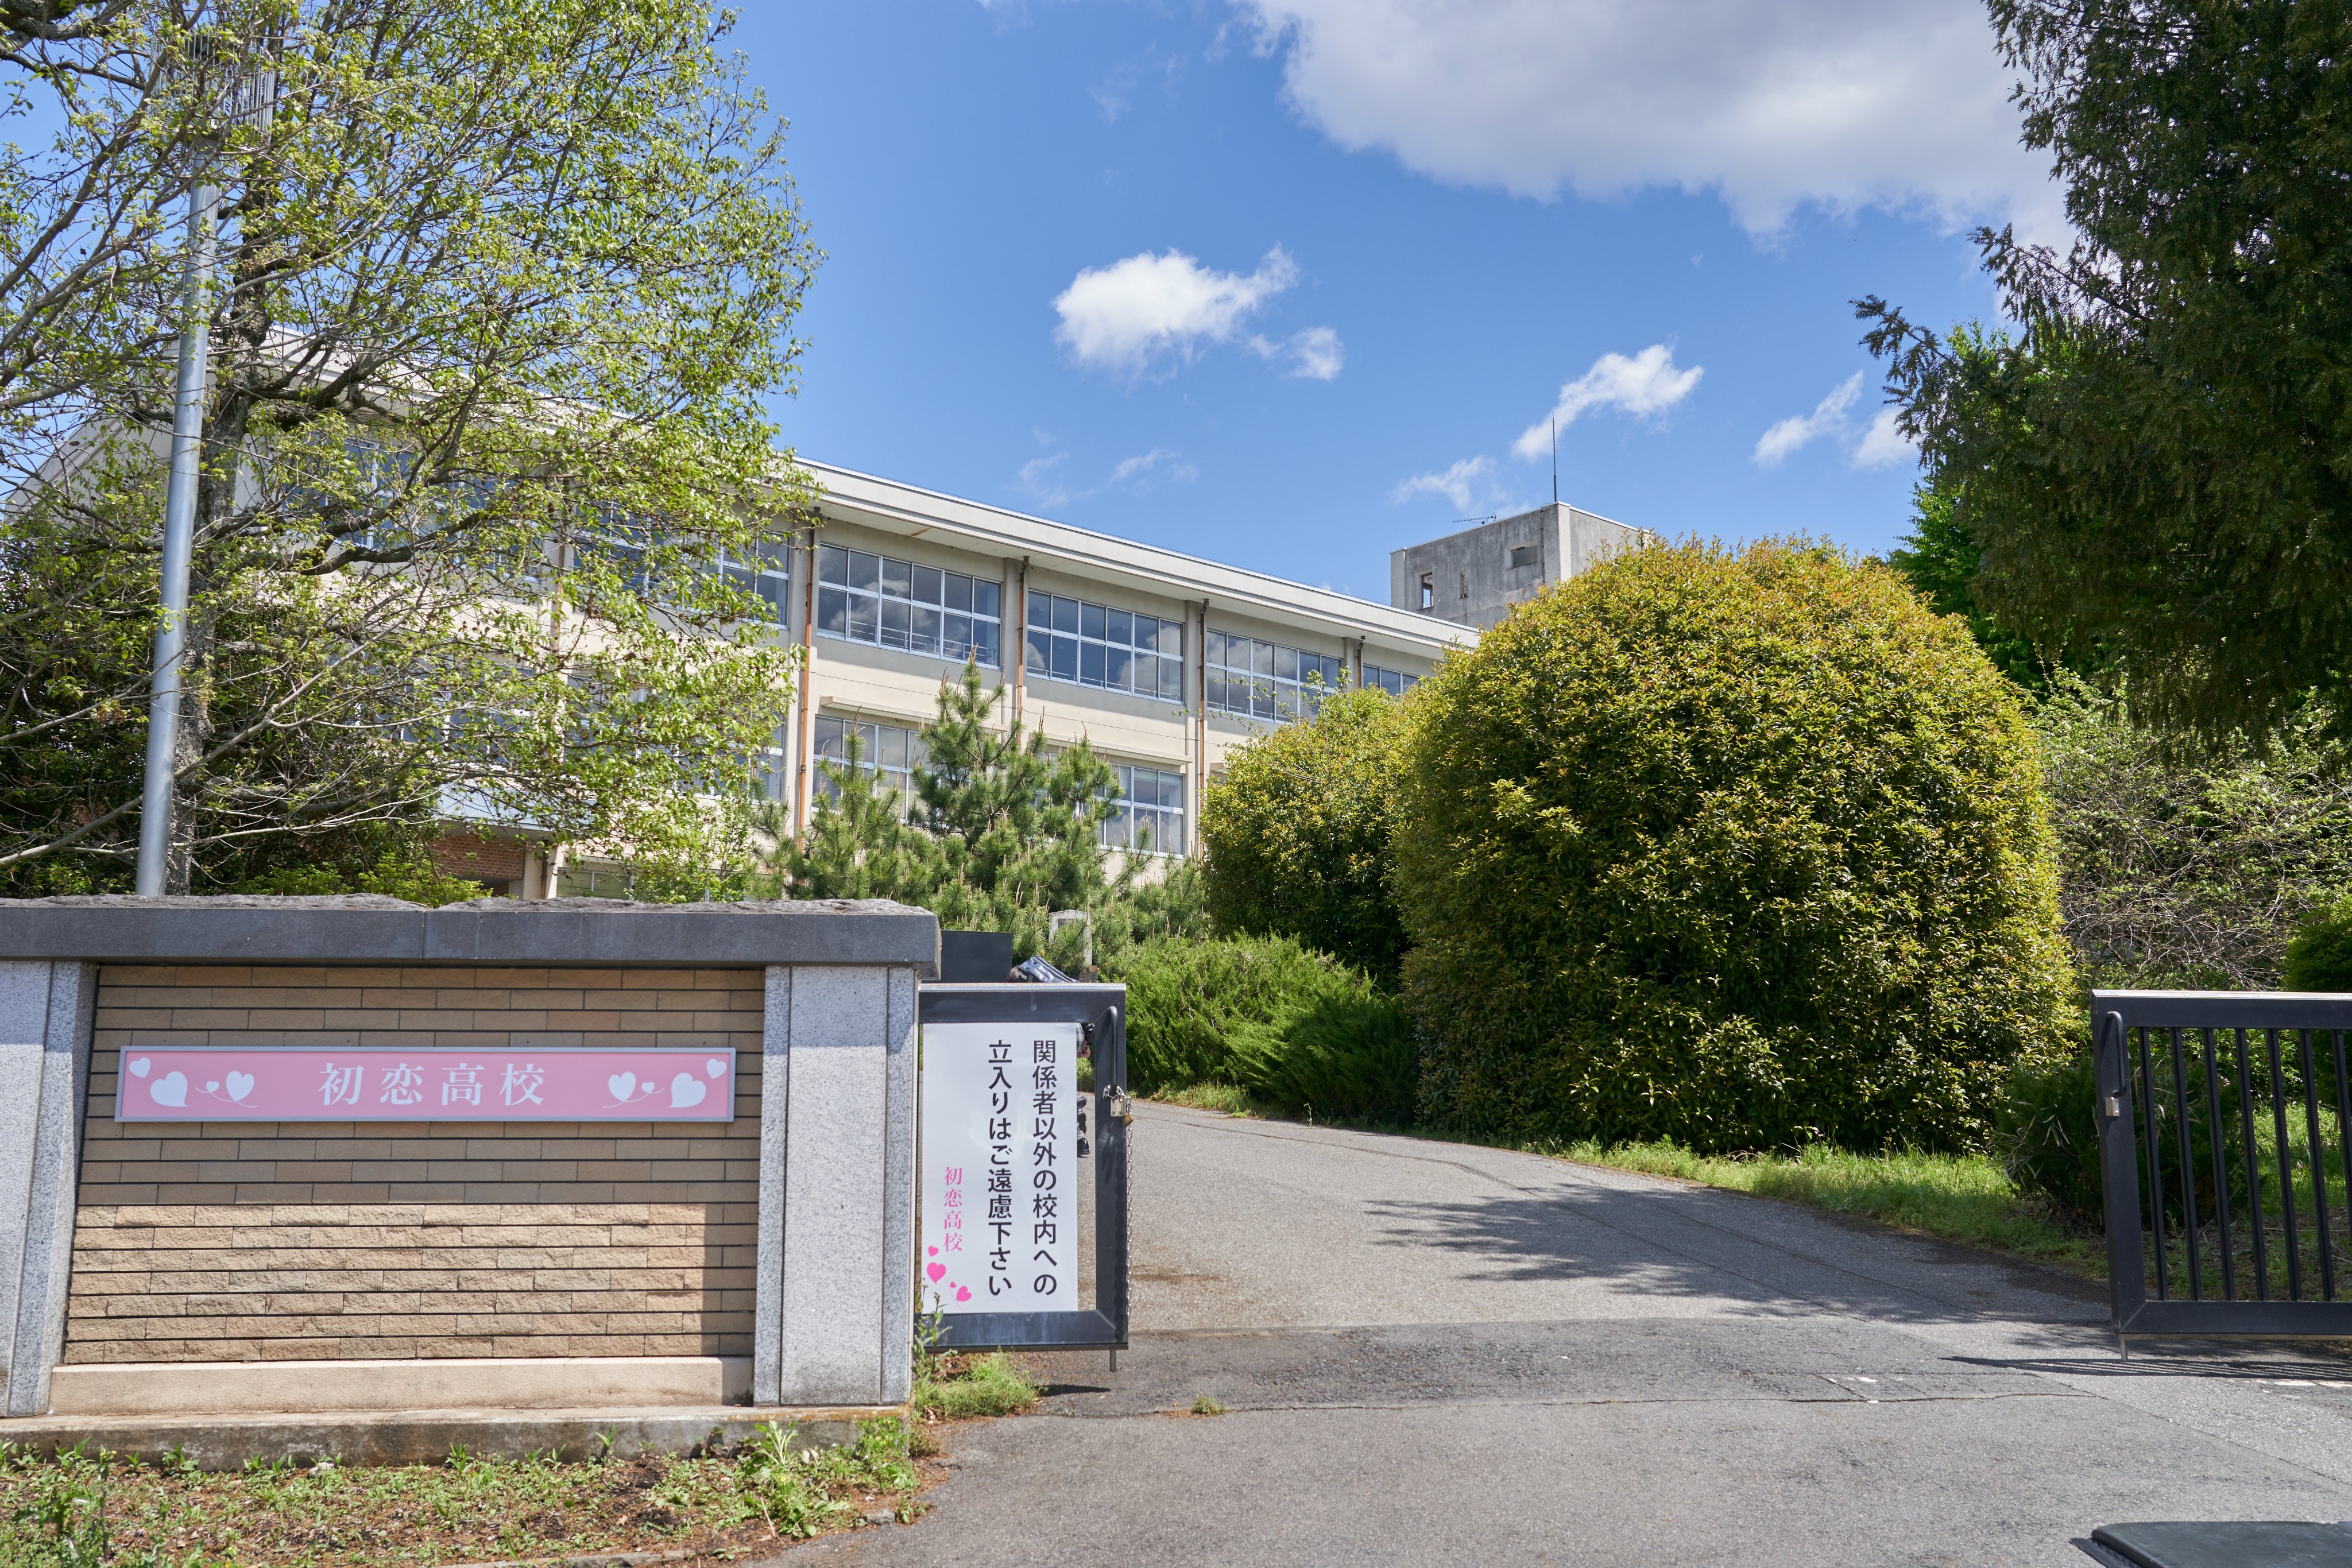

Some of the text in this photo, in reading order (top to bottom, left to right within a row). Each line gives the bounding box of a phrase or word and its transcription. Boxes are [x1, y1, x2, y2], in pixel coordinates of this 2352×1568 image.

[318, 1062, 546, 1106] 初恋高校
[987, 1039, 1013, 1296] 立入りはご遠慮下さい
[1032, 1040, 1058, 1296] 関係者以外の校内への
[943, 1166, 963, 1252] 初恋高校
